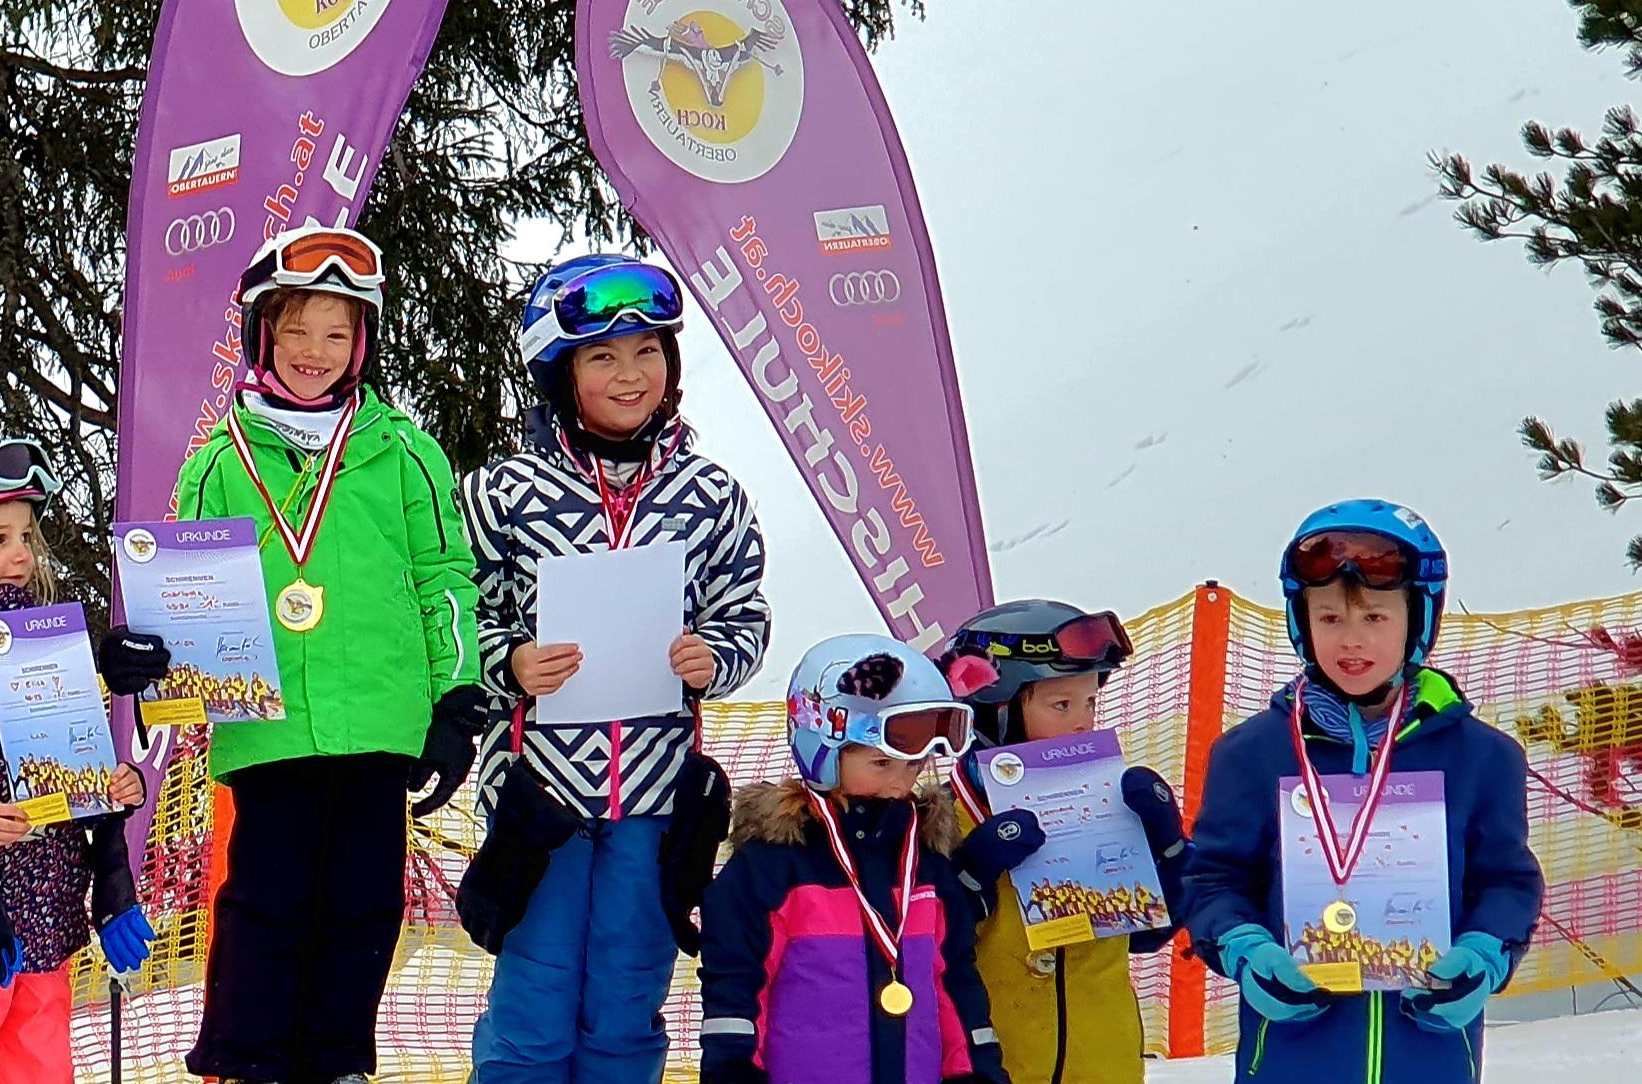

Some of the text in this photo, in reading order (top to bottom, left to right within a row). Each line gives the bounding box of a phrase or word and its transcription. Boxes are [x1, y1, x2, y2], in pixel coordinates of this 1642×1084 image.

[170, 170, 235, 194] OBERTAUERN
[175, 529, 231, 543] URKUNDE
[24, 615, 68, 632] URKUNDE
[1041, 742, 1095, 761] URKUNDE
